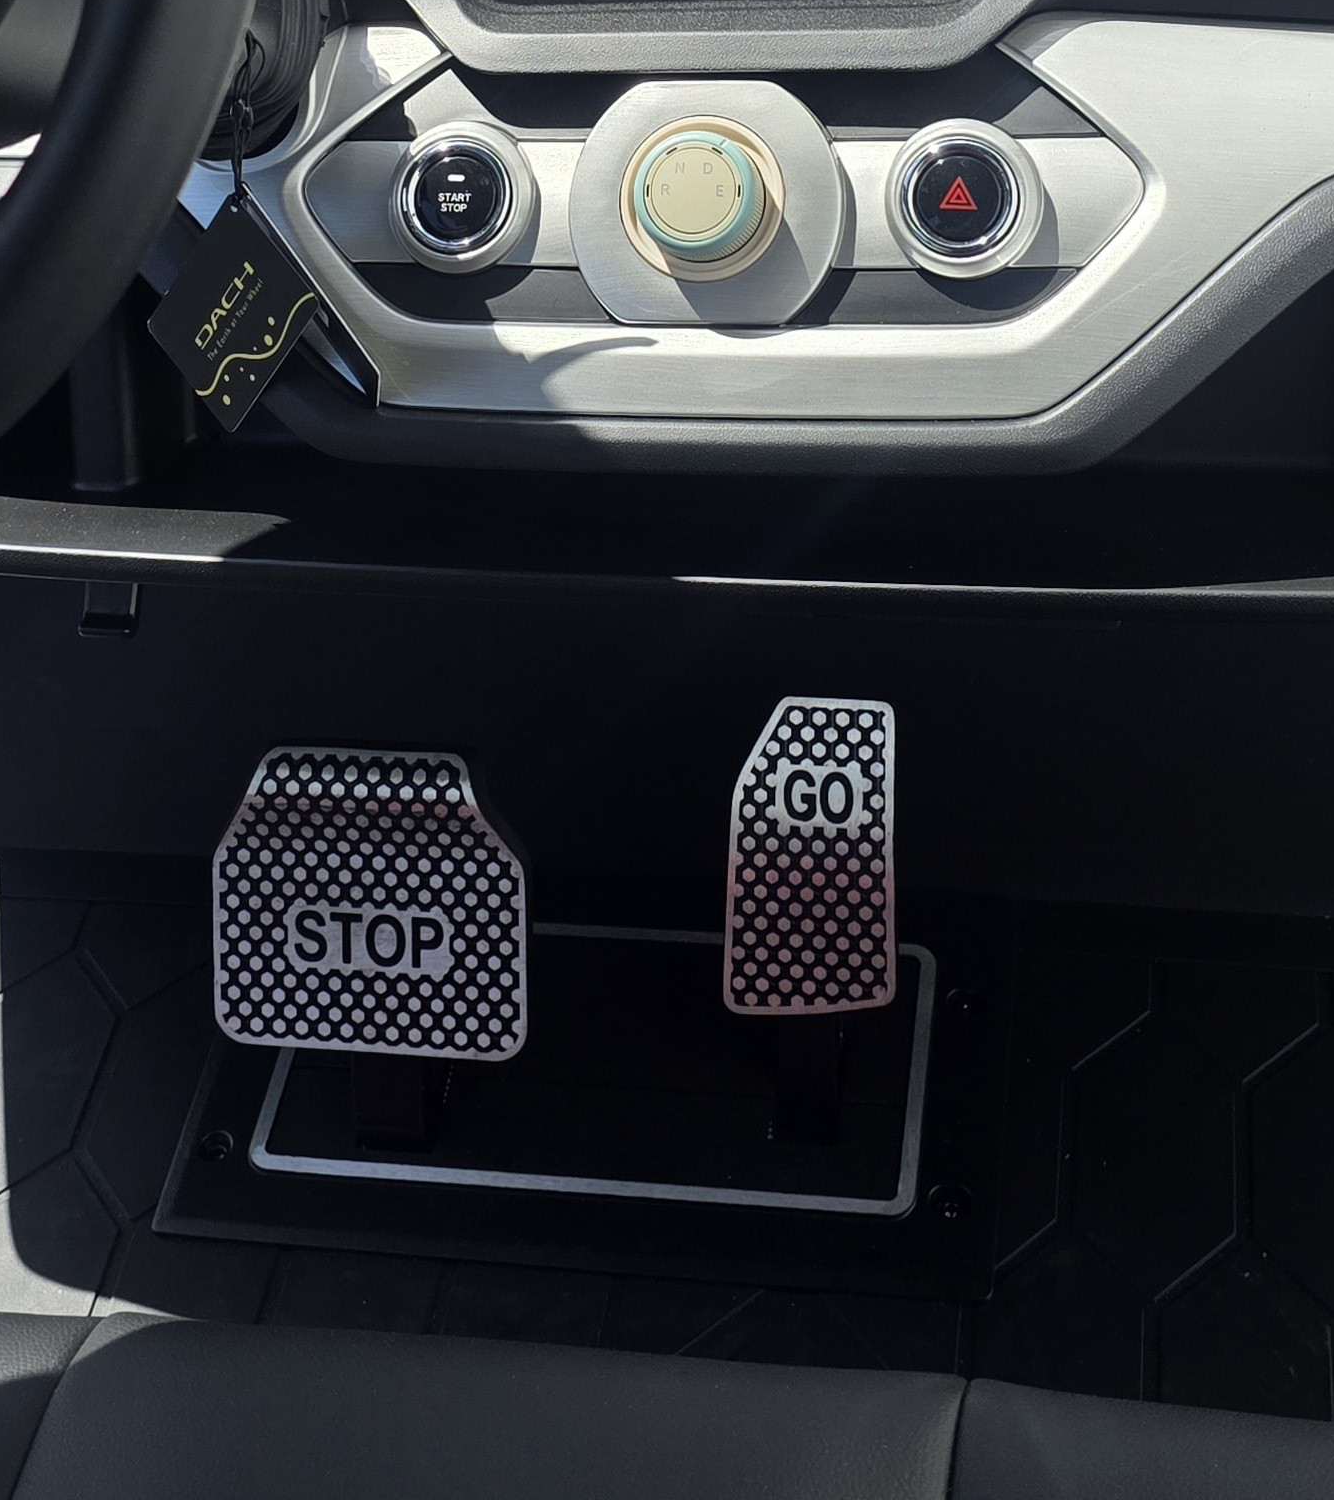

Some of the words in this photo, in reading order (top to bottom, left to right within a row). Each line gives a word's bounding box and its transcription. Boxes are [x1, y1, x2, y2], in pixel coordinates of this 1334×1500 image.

[674, 161, 686, 175] N
[702, 161, 714, 175] D
[437, 192, 473, 203] START
[440, 202, 468, 213] STOP
[660, 183, 671, 197] R
[715, 184, 725, 198] E
[194, 260, 255, 351] DACH
[207, 347, 219, 362] The
[215, 327, 232, 349] Earth
[234, 301, 249, 319] Your
[246, 276, 264, 302] Wheel
[782, 767, 857, 827] GO
[292, 908, 448, 972] STOP
